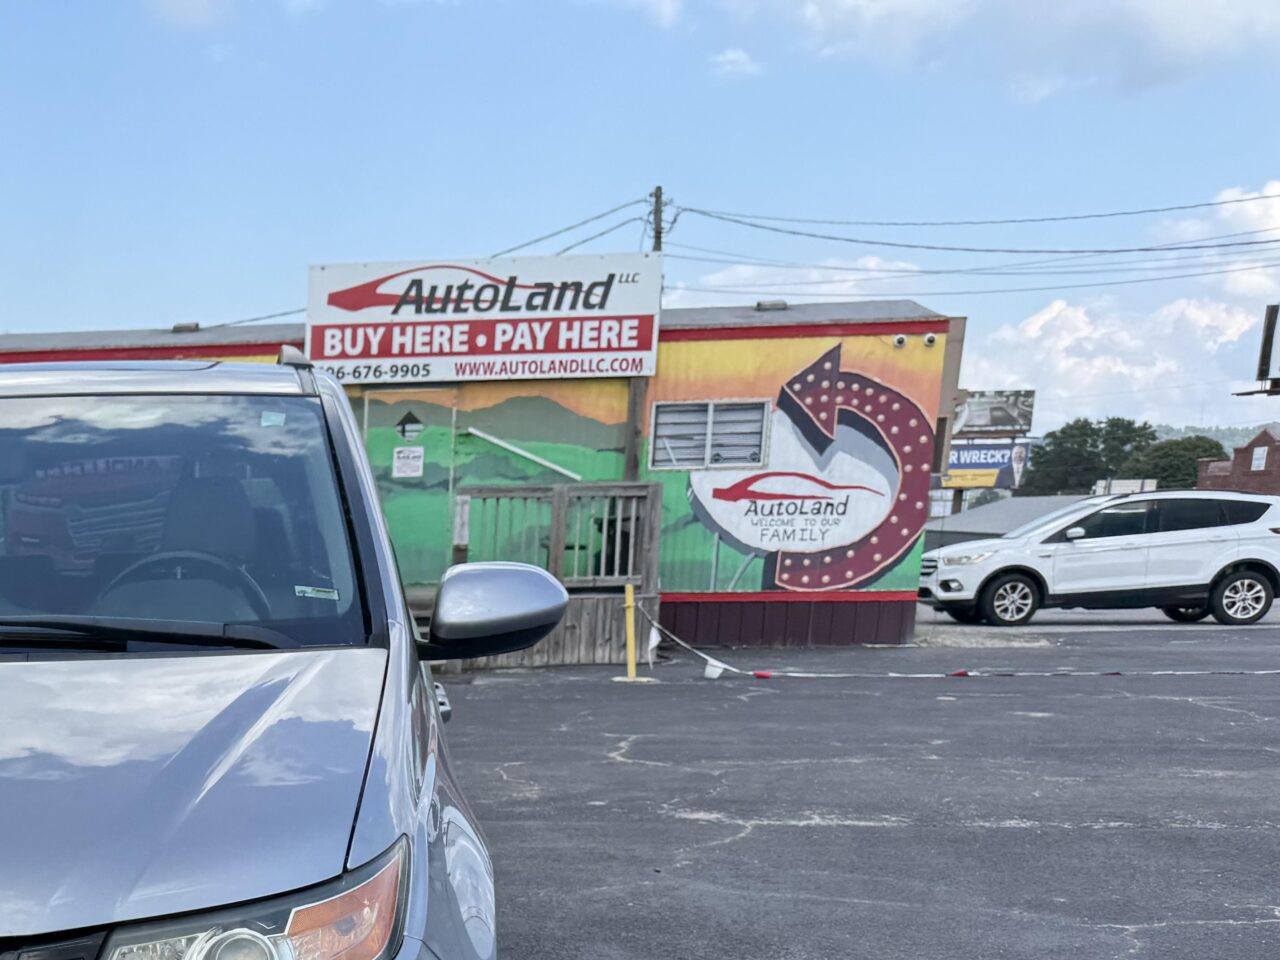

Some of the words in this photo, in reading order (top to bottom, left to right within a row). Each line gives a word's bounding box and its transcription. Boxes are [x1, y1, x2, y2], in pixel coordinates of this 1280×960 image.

[391, 273, 616, 315] AutoLand
[618, 272, 640, 284] LLC
[323, 325, 386, 357] BUY
[391, 323, 470, 355] HERE
[493, 321, 552, 352] PAY
[557, 319, 639, 350] HERE
[320, 363, 432, 380] 06-676-9905
[454, 357, 644, 377] WWW.AUTOLANDLLC.COM
[959, 449, 1011, 464] WRECK?
[744, 494, 850, 517] AutoLand
[750, 517, 796, 528] WELCOME
[803, 518, 817, 527] TO
[820, 518, 841, 527] OUR
[759, 528, 830, 543] FAMILY
